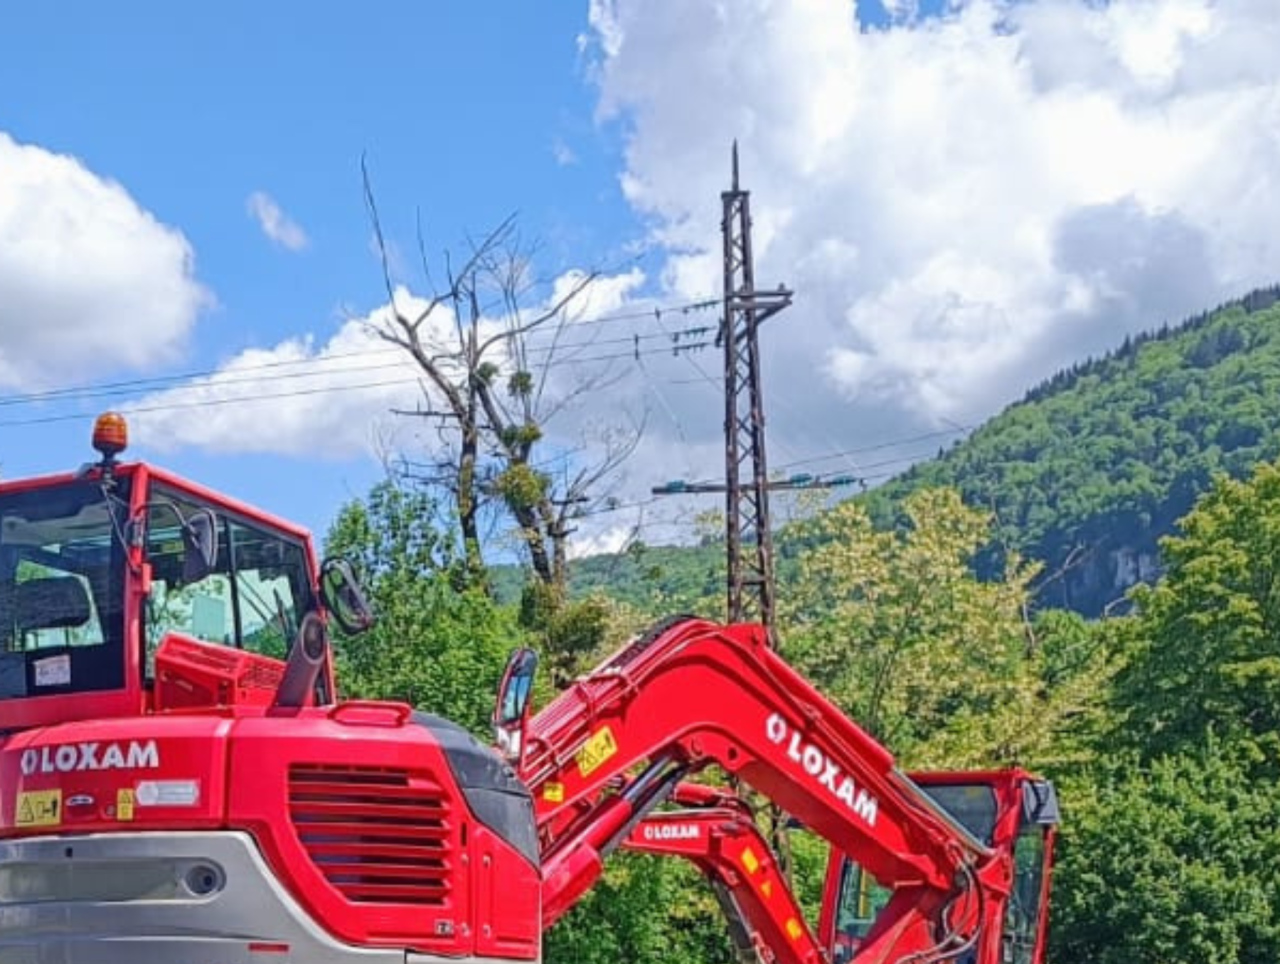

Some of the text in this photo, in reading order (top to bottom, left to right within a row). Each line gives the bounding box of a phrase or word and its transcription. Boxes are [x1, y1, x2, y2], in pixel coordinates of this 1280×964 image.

[42, 740, 159, 773] LOXAM
[787, 730, 878, 827] LOXAM
[654, 824, 699, 839] LOXAM
